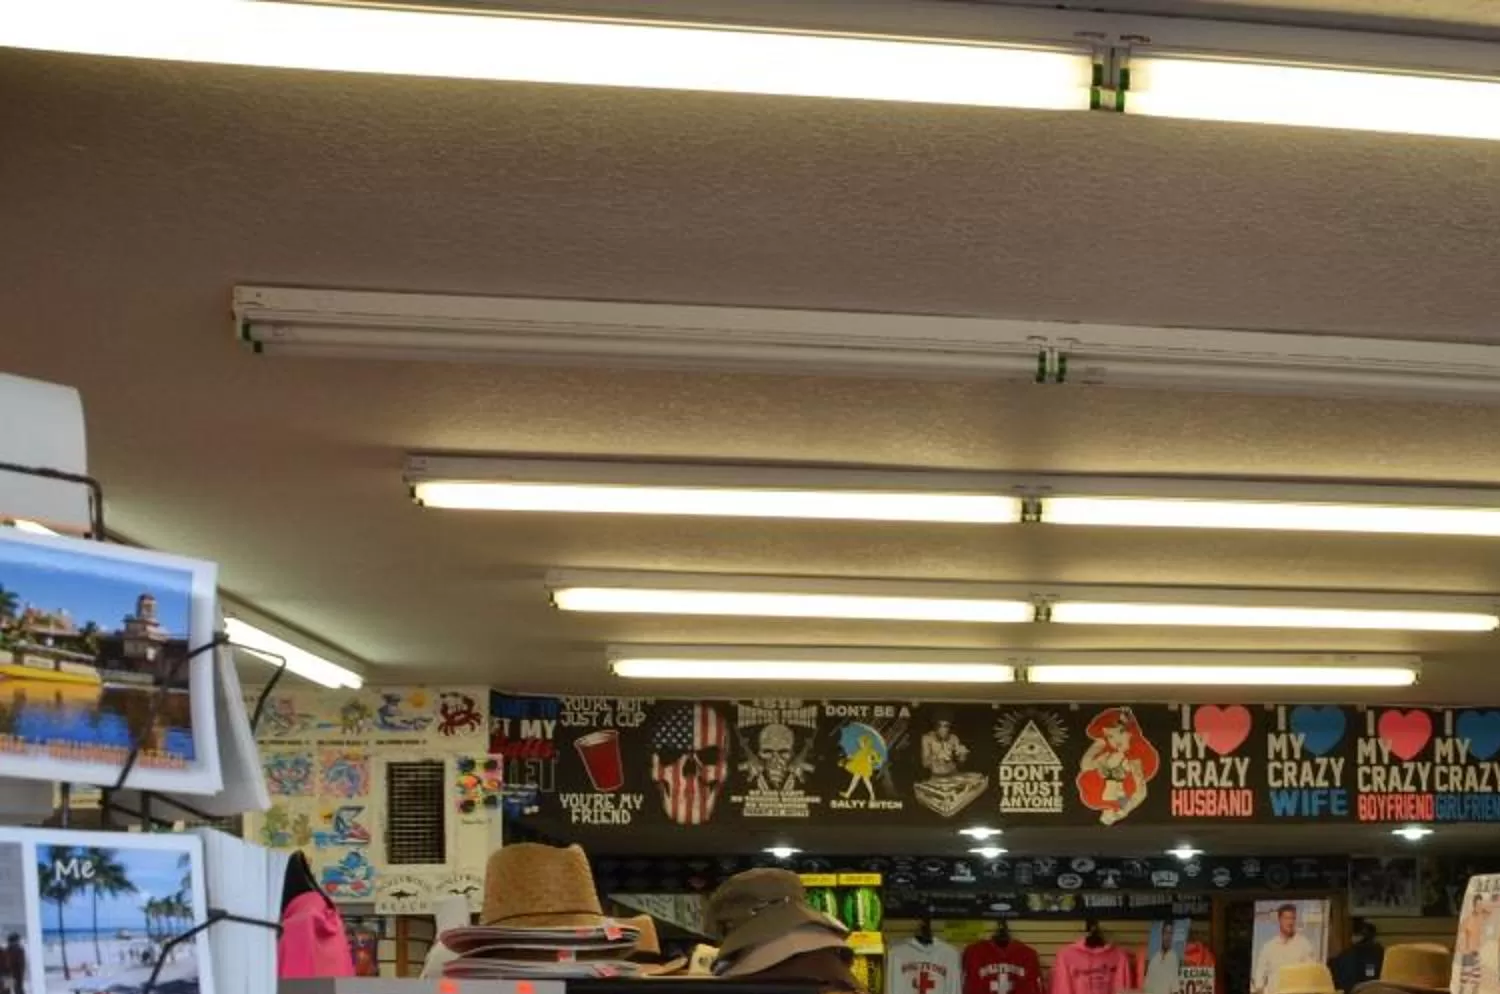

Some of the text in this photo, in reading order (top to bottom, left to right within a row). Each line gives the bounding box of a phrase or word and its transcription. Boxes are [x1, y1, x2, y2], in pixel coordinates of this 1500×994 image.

[560, 711, 648, 728] JUST A CUP
[873, 705, 896, 718] BE
[898, 705, 912, 718] A
[1181, 704, 1191, 731] I
[1277, 704, 1287, 731] I
[1366, 709, 1376, 737] I
[1443, 709, 1454, 737] I
[519, 719, 558, 740] MY
[1171, 731, 1210, 760] MY
[1267, 732, 1307, 760] MY
[1356, 737, 1393, 766] MY
[1433, 737, 1472, 766] MY
[999, 765, 1064, 782] DON'T
[1171, 756, 1251, 789] CRAZY
[1267, 756, 1346, 789] CRAZY
[1356, 761, 1433, 794] CRAZY
[618, 793, 645, 811] MY
[1000, 781, 1064, 798] TRUST
[1000, 796, 1064, 809] ANYONE
[1170, 788, 1255, 818] HUSBAND
[1268, 788, 1349, 818] WIFE
[570, 808, 632, 826] FRIEND
[829, 799, 867, 810] SALTY
[1356, 793, 1435, 822] BOYFRIEND
[54, 857, 97, 881] Me
